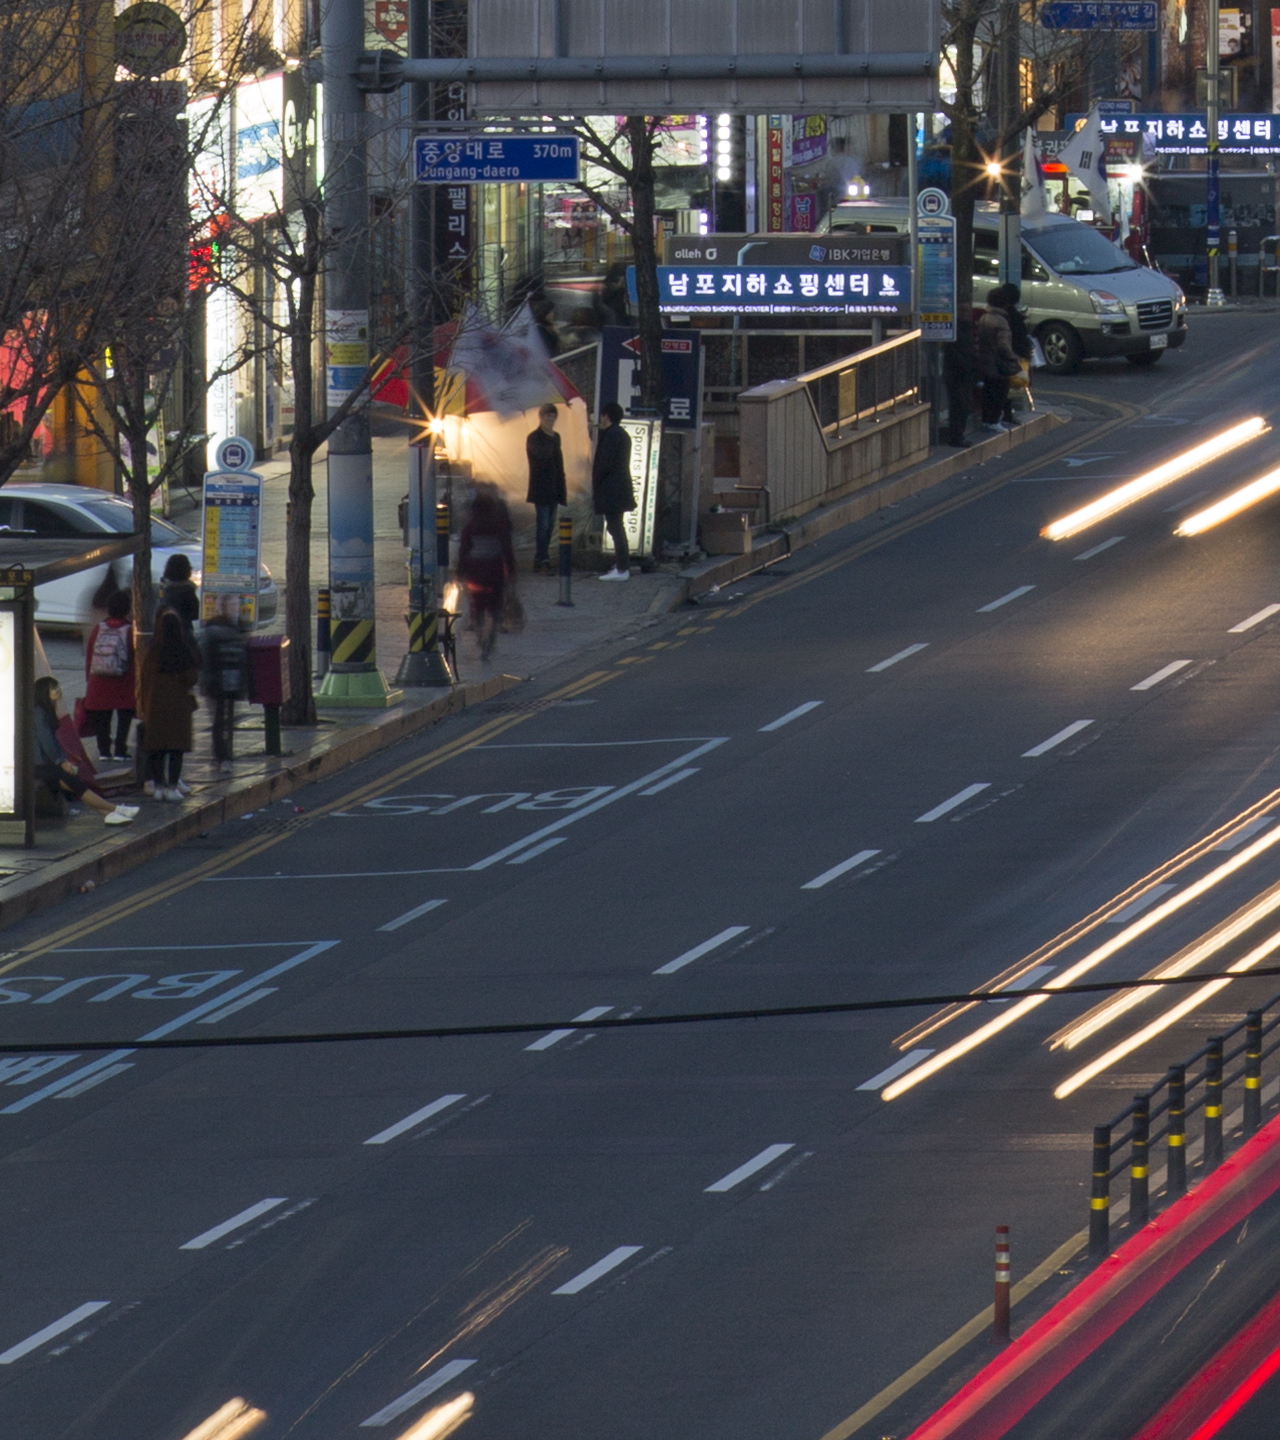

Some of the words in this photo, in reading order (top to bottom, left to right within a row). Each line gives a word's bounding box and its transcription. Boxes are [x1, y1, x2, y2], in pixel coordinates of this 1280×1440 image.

[422, 141, 505, 163] 중앙대로
[533, 144, 573, 160] 370m
[422, 164, 520, 180] Jungang-daero
[674, 248, 703, 260] olleh
[828, 248, 891, 262] IBK기업은행
[667, 273, 870, 297] 남포지하쇼핑센터
[668, 397, 691, 421] 료
[632, 425, 647, 471] Sports
